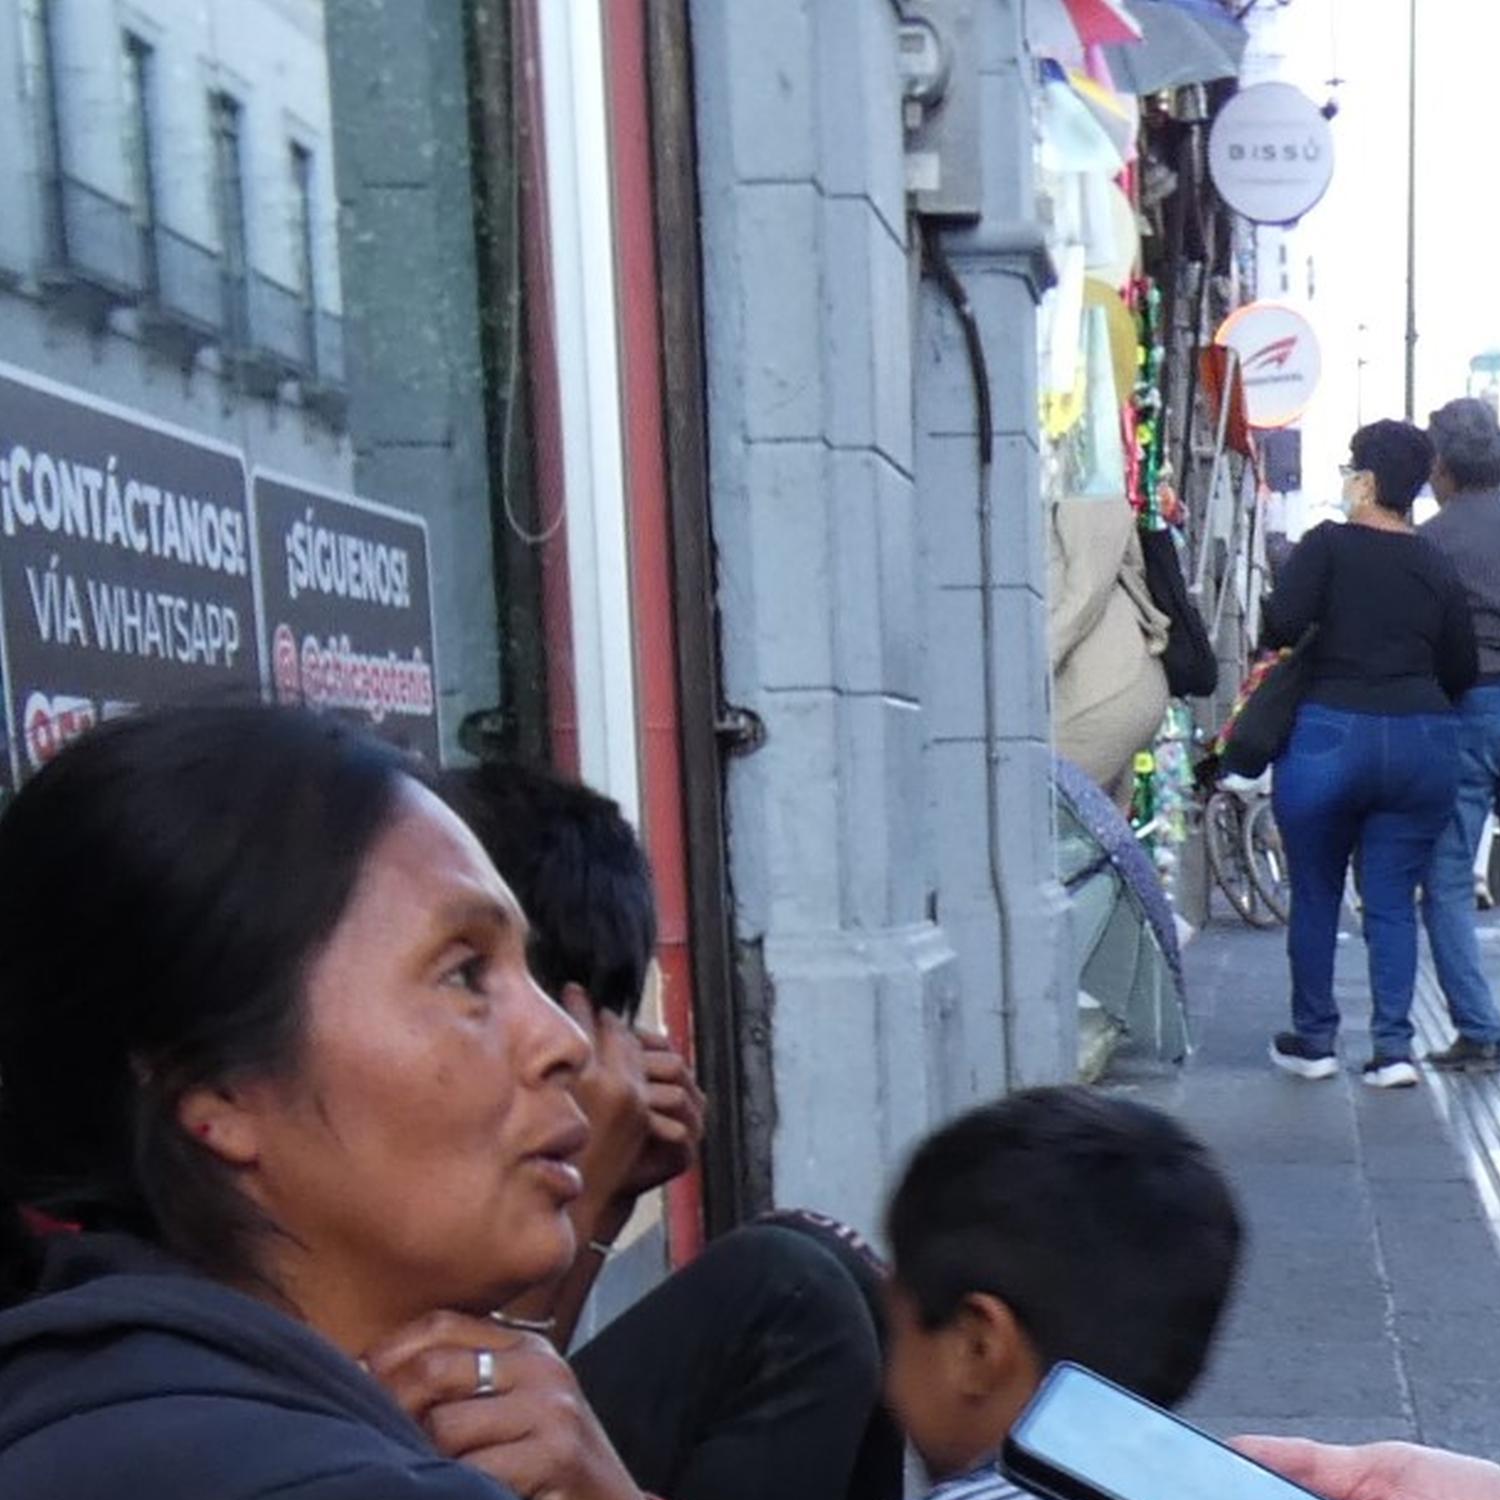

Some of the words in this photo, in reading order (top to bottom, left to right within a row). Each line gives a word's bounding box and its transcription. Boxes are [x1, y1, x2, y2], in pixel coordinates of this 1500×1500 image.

[0, 445, 247, 577] ¡CONTÁCTANOS!
[285, 506, 411, 608] ¡SÍGUENOS!
[25, 552, 89, 648] VÍA
[87, 579, 240, 669] WHATSAPP
